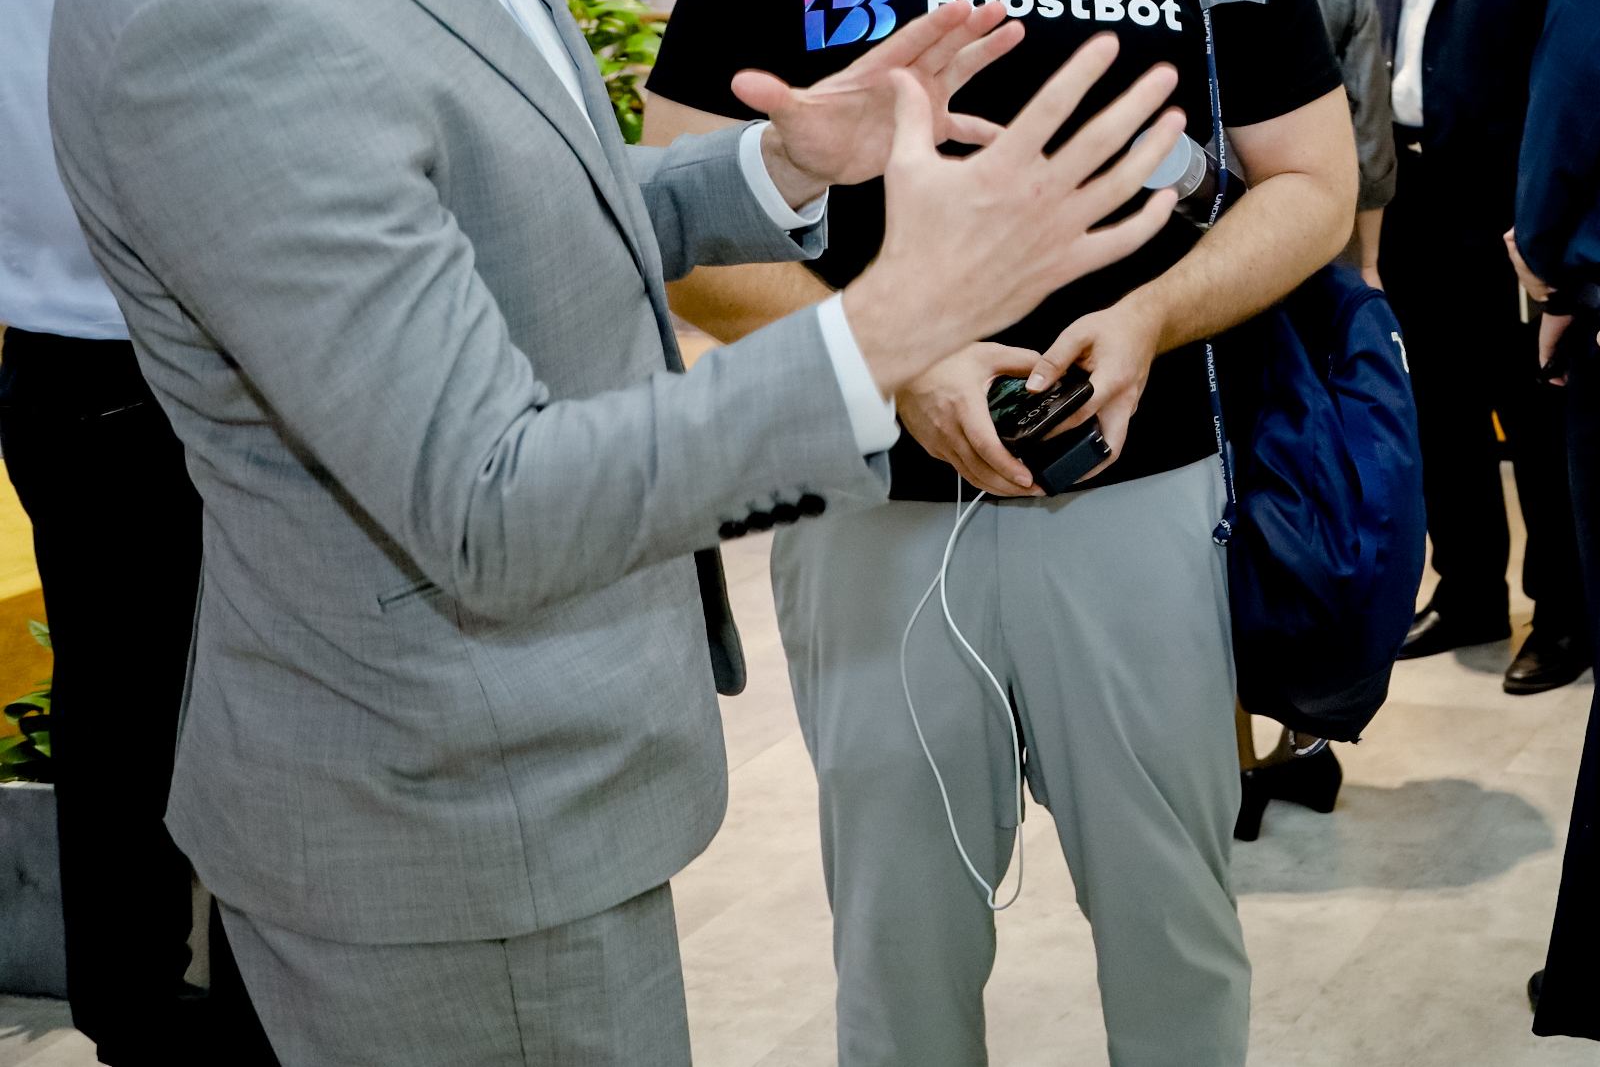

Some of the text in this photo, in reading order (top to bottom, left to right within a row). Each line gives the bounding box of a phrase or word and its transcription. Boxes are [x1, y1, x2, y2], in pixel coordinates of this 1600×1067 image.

[1218, 120, 1226, 170] ARMOUR
[1205, 343, 1217, 393] ARMOUR
[1213, 415, 1223, 454] UNDER
